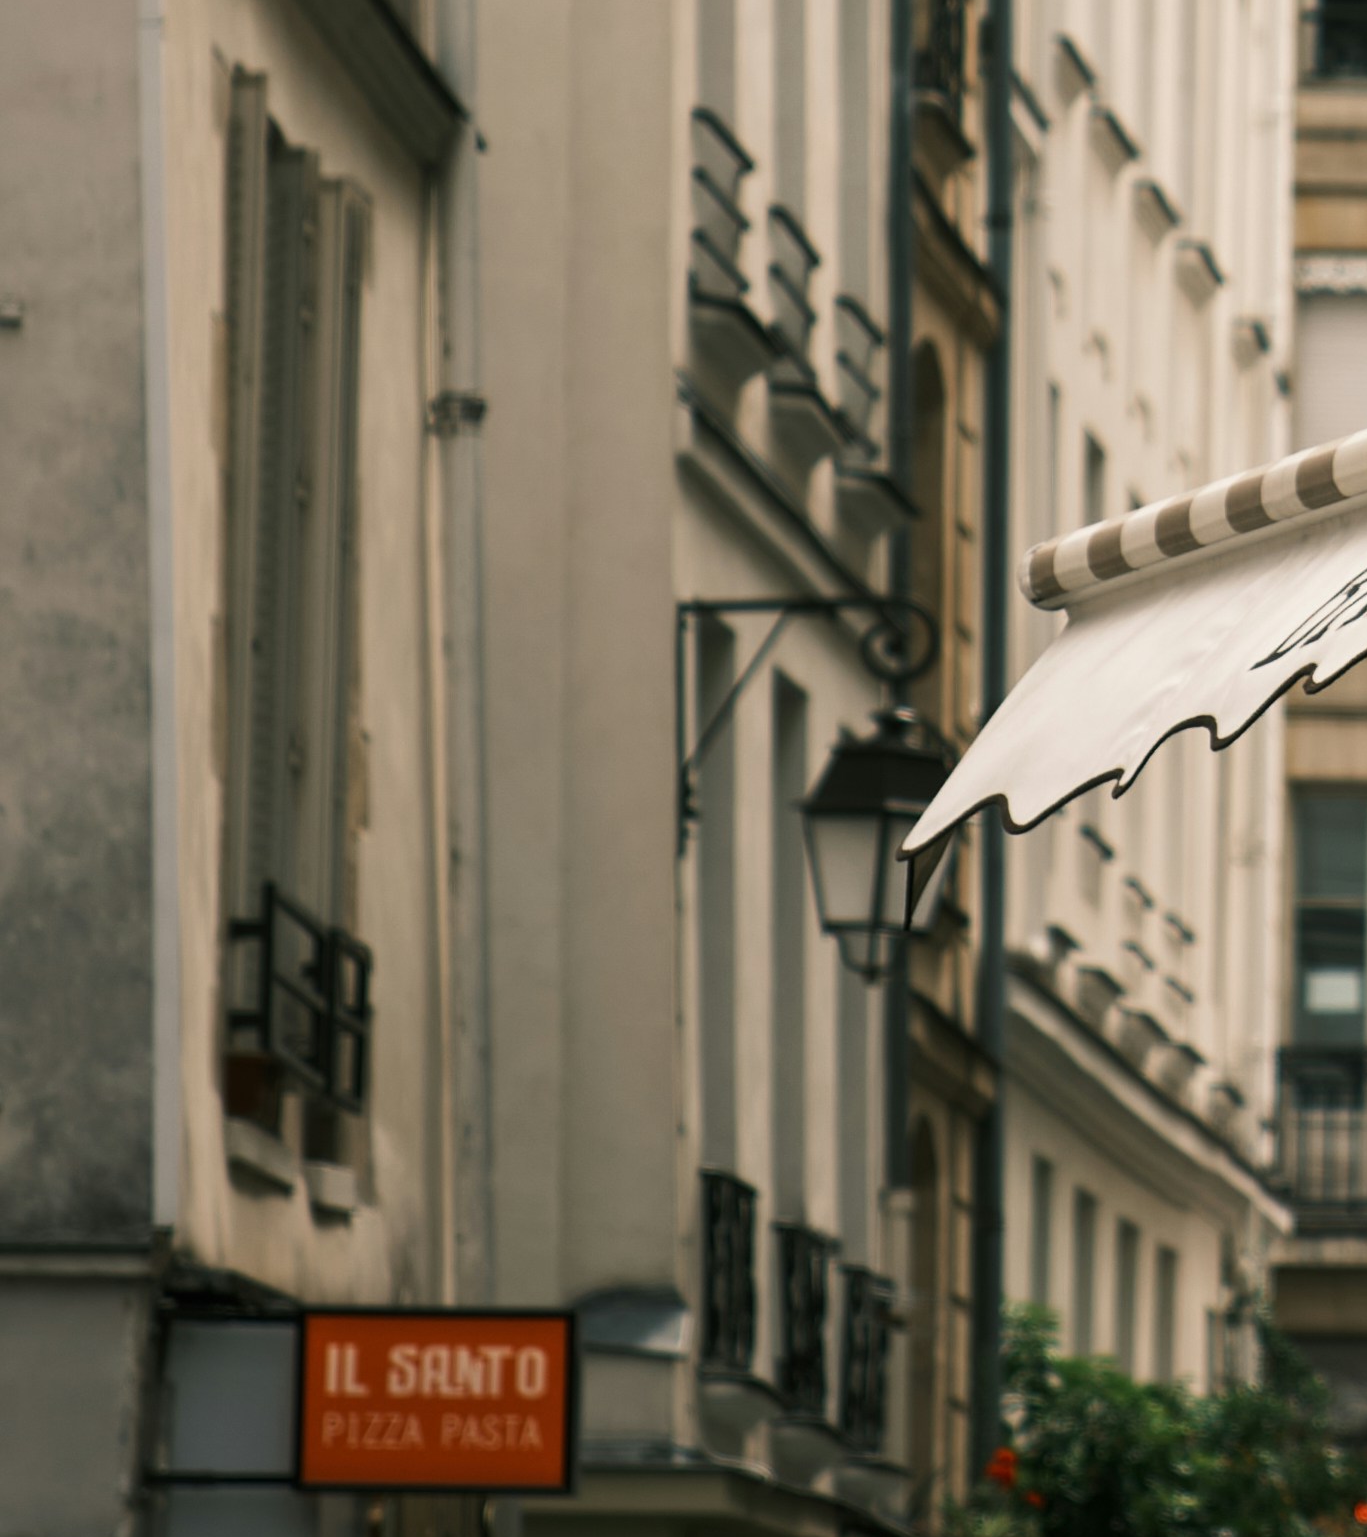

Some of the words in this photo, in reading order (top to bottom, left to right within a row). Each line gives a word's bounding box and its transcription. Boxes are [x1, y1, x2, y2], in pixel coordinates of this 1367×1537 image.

[323, 1340, 371, 1399] IL
[386, 1340, 548, 1401] SANTO
[321, 1410, 425, 1451] PIZZA
[440, 1411, 545, 1453] PASTA
